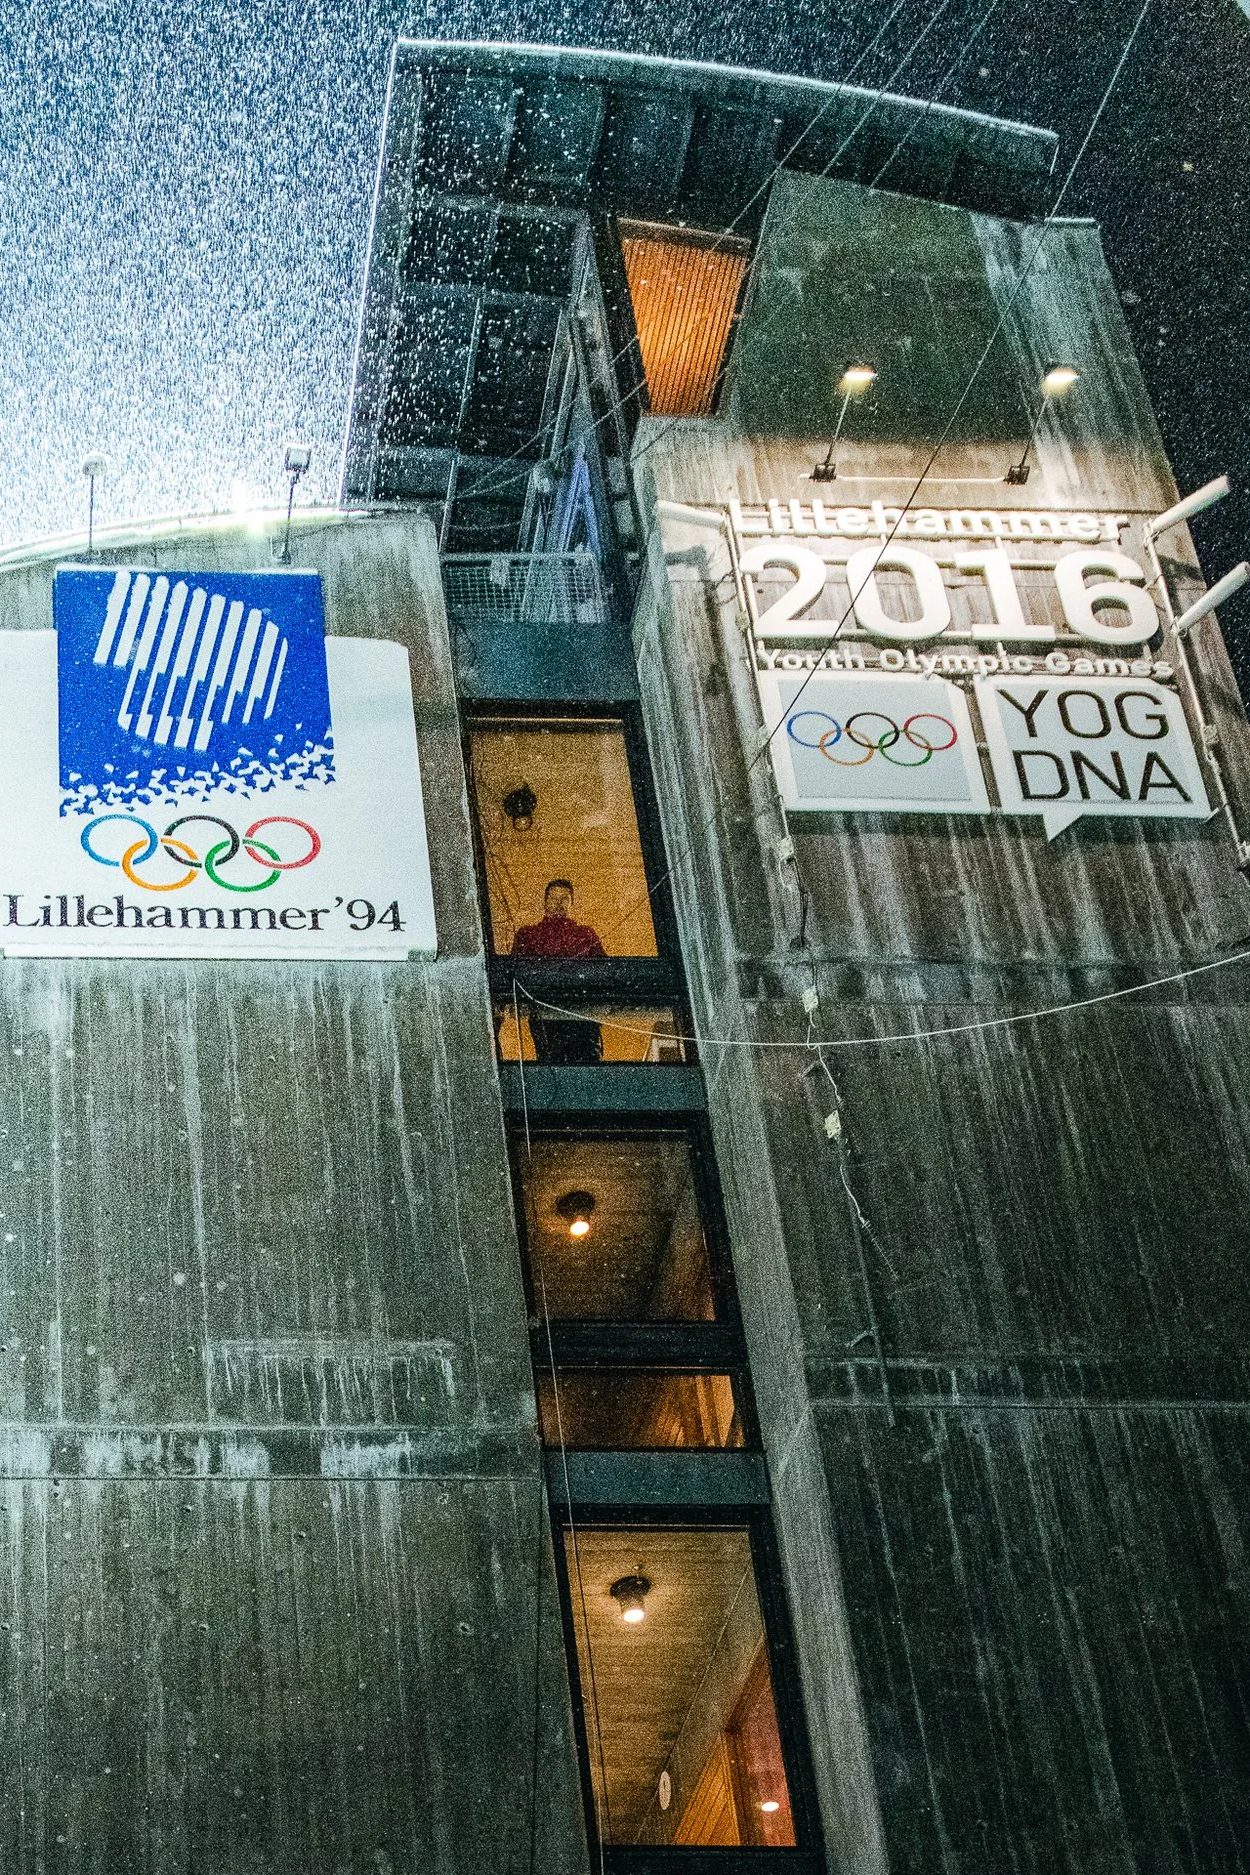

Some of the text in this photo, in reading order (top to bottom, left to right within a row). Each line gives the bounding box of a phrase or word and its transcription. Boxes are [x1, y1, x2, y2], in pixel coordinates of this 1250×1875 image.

[730, 498, 1128, 541] Lillehammer
[739, 545, 1160, 644] 2016
[758, 649, 1174, 681] Youth Olympic Games
[996, 689, 1170, 739] YOG
[1012, 750, 1192, 801] DNA
